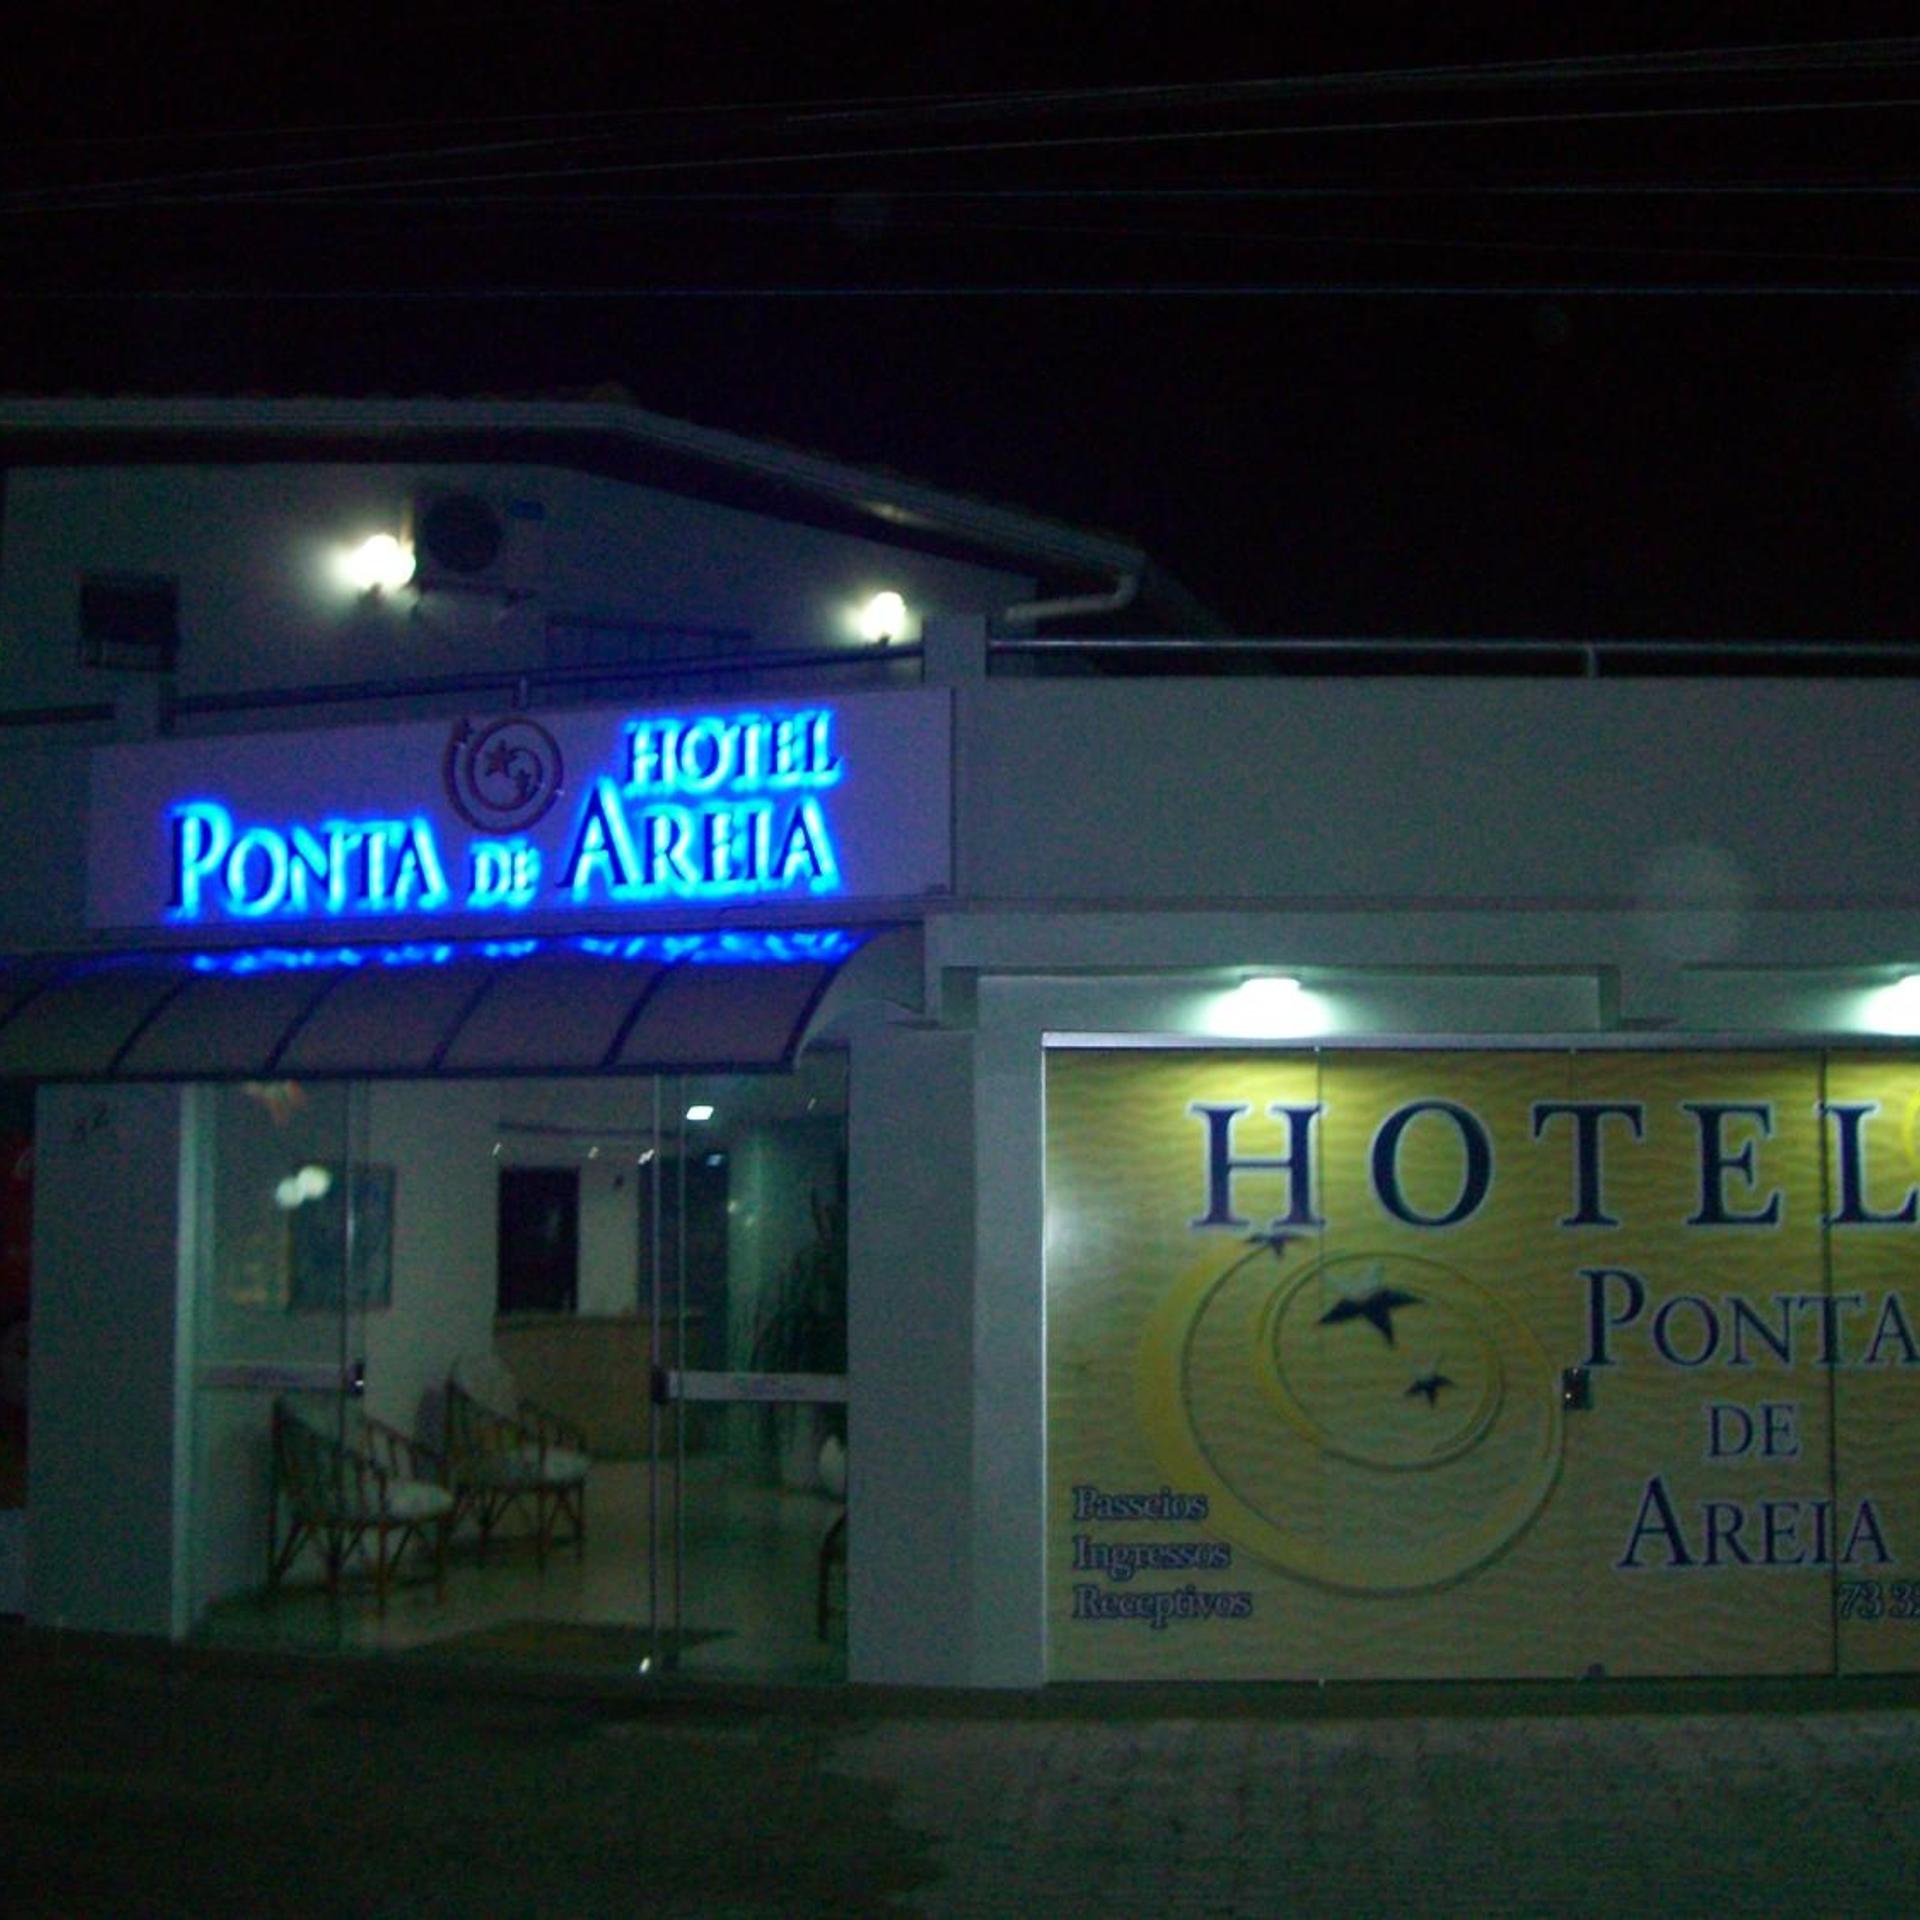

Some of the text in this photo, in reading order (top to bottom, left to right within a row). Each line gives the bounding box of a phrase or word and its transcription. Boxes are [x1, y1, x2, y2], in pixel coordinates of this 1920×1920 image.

[624, 709, 842, 796] HOTEL
[165, 776, 840, 918] PONTA DE AREIA
[1190, 1099, 1920, 1229] HOTEL
[1580, 1267, 1920, 1367] PONTA
[1708, 1404, 1801, 1459] DE
[1073, 1486, 1208, 1522] Passeios
[1618, 1475, 1894, 1568] AREIA
[1073, 1535, 1231, 1582] Ingressos
[1073, 1583, 1253, 1630] Receptivos
[1838, 1580, 1885, 1620] 73
